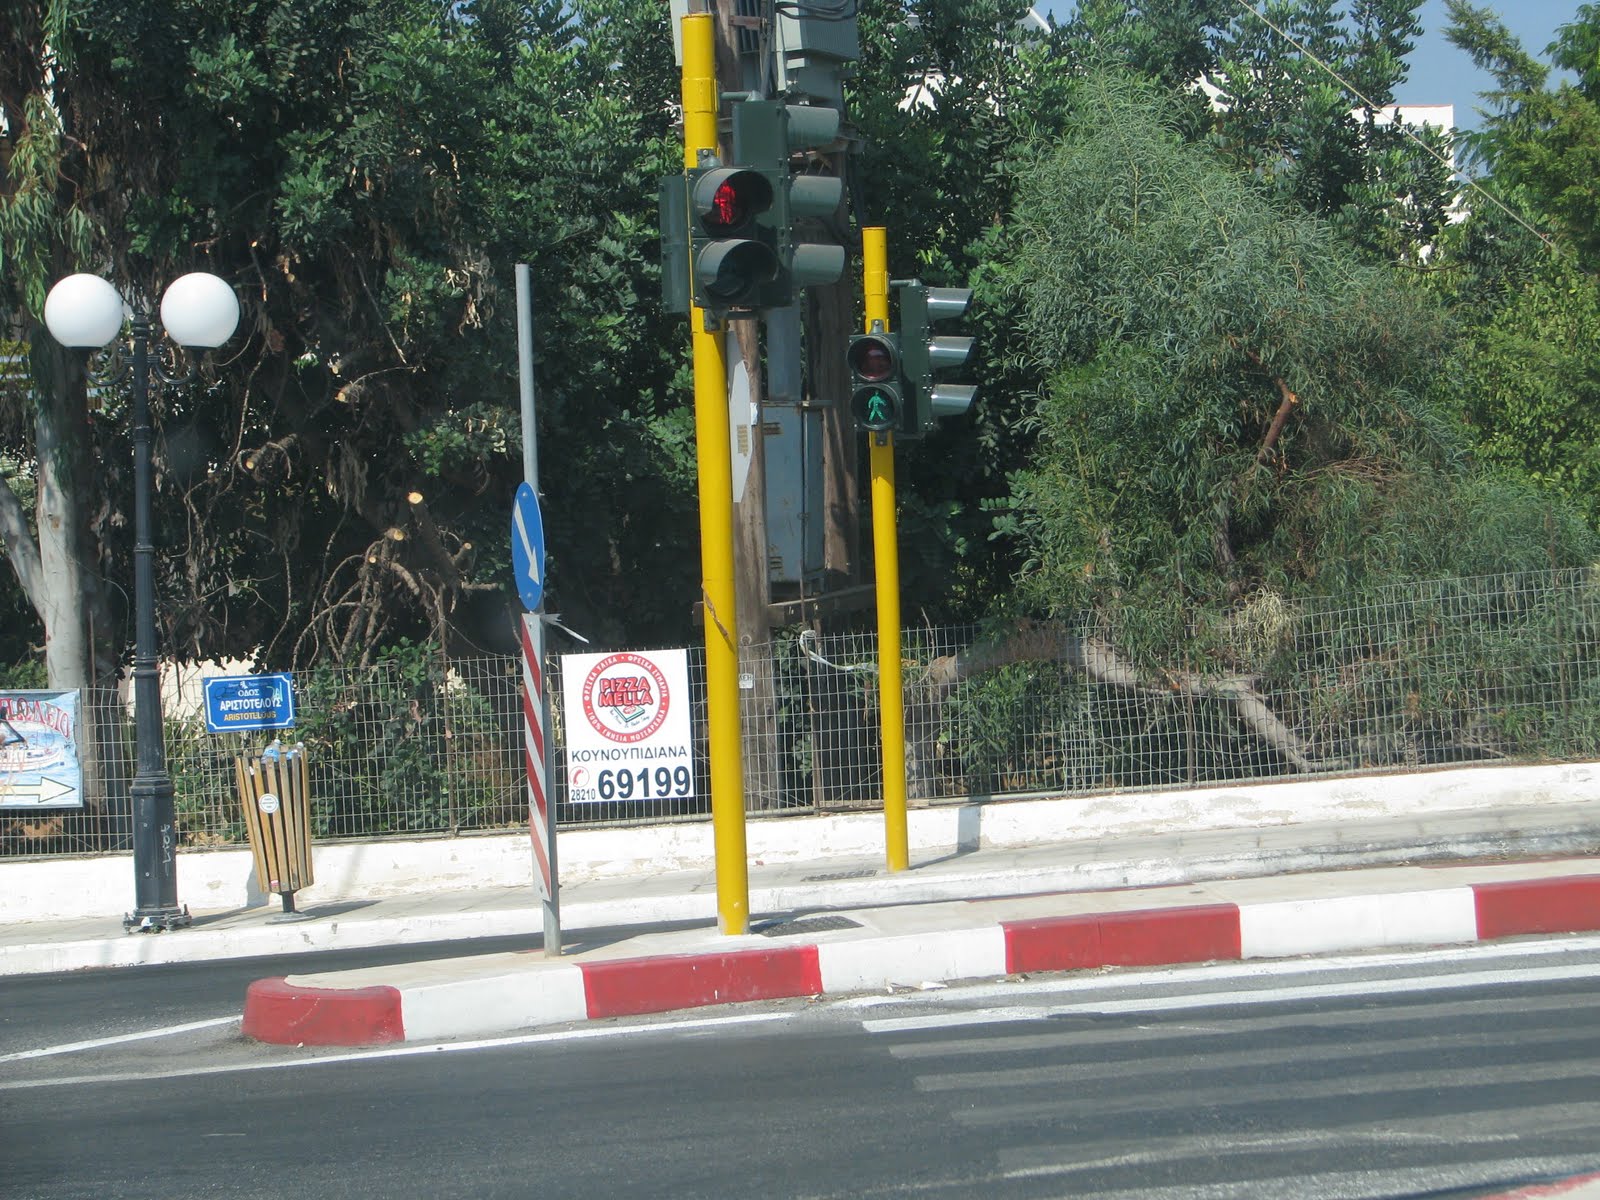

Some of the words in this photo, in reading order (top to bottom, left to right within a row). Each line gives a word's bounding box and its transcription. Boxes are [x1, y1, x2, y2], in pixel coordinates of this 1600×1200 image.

[599, 676, 651, 693] PIZZA
[238, 689, 259, 697] ΟΔΟΣ
[598, 691, 654, 707] MELLA
[220, 697, 282, 711] ΑΡΙΣΤΟΤΕΛΟΥΣ
[224, 711, 277, 721] ARISTOTELOUS
[571, 746, 687, 762] ΚΟΥΝΟΥΠΙΔΙΑΝΑ
[571, 788, 596, 801] 28210
[598, 766, 691, 800] 69199
